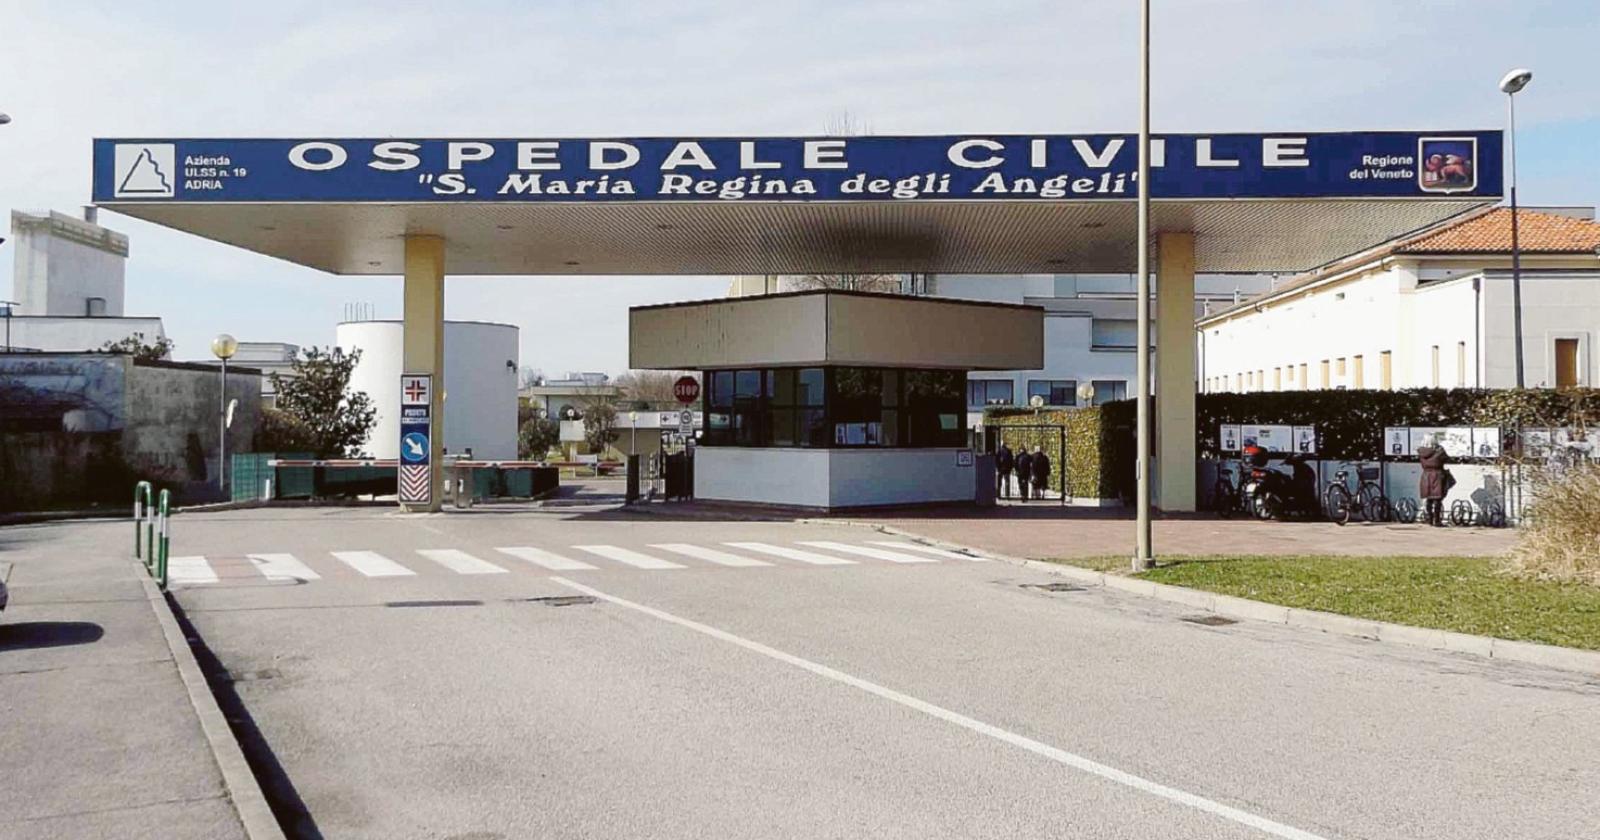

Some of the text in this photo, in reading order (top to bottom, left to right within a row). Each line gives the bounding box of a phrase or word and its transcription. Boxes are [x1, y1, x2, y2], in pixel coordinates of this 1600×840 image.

[288, 138, 1310, 171] OSPEDALE CIVILE
[184, 155, 231, 166] Azienda
[1362, 154, 1414, 167] Regione
[184, 167, 248, 177] ULSS n. 19
[1349, 168, 1414, 179] del Veneto
[184, 179, 223, 190] ADRIA
[419, 173, 477, 195] "S.
[496, 173, 636, 194] Maria
[657, 173, 817, 199] Regina
[840, 172, 951, 199] degli
[675, 384, 699, 396] STOP
